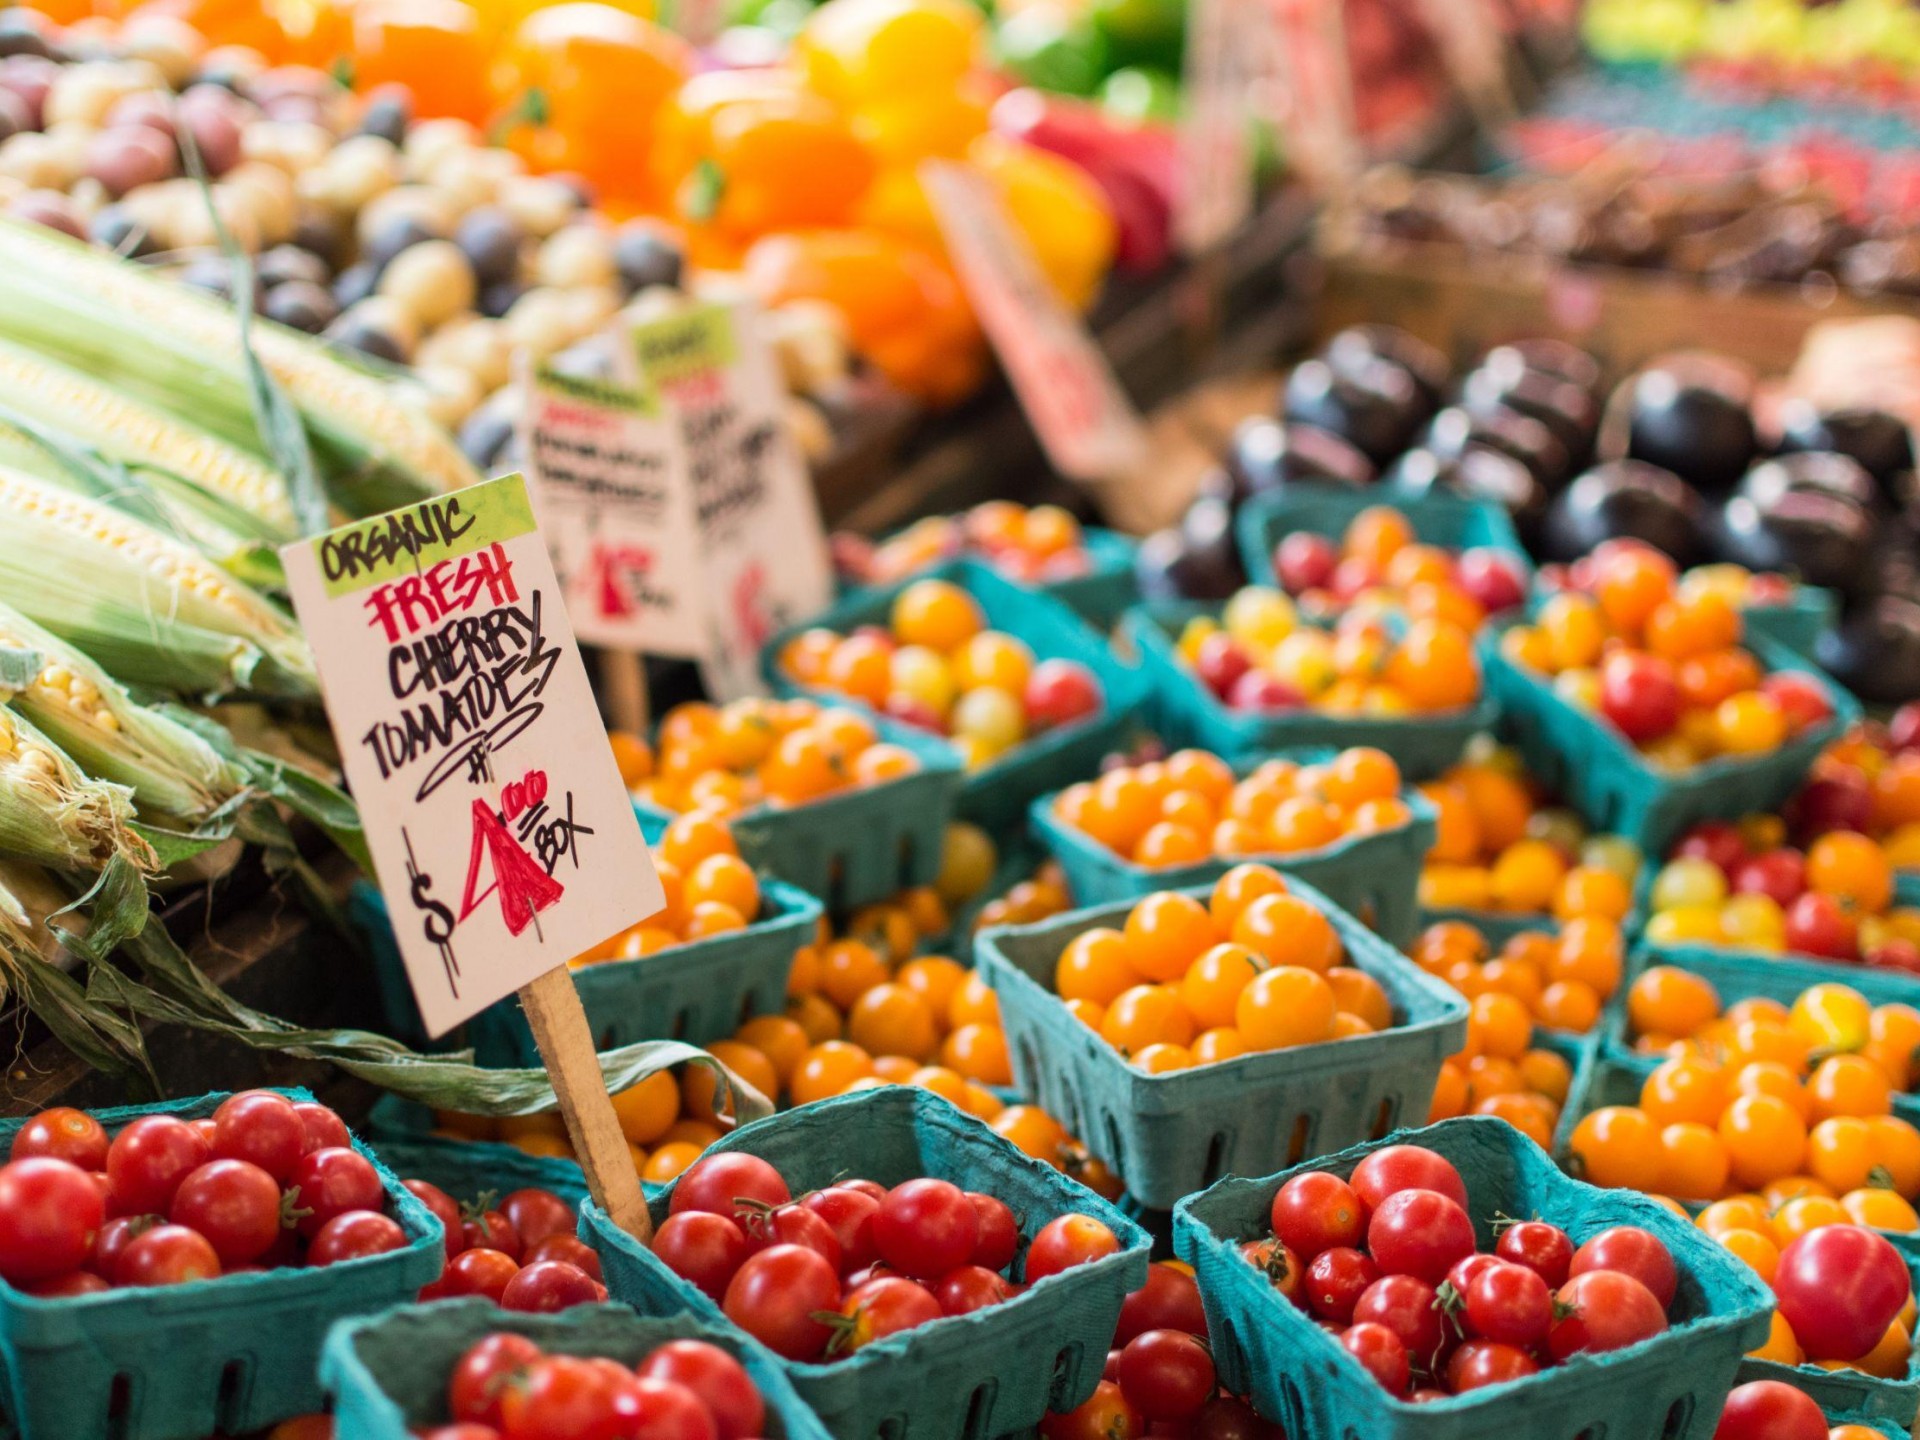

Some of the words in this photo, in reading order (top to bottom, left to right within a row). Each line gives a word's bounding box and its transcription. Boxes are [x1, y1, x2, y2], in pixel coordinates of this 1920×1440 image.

[321, 498, 475, 582] ORGANIC
[363, 541, 520, 643] FRESH
[388, 589, 542, 700] CHERRY
[362, 637, 562, 780] TOMATOES
[534, 791, 594, 877] BOX
